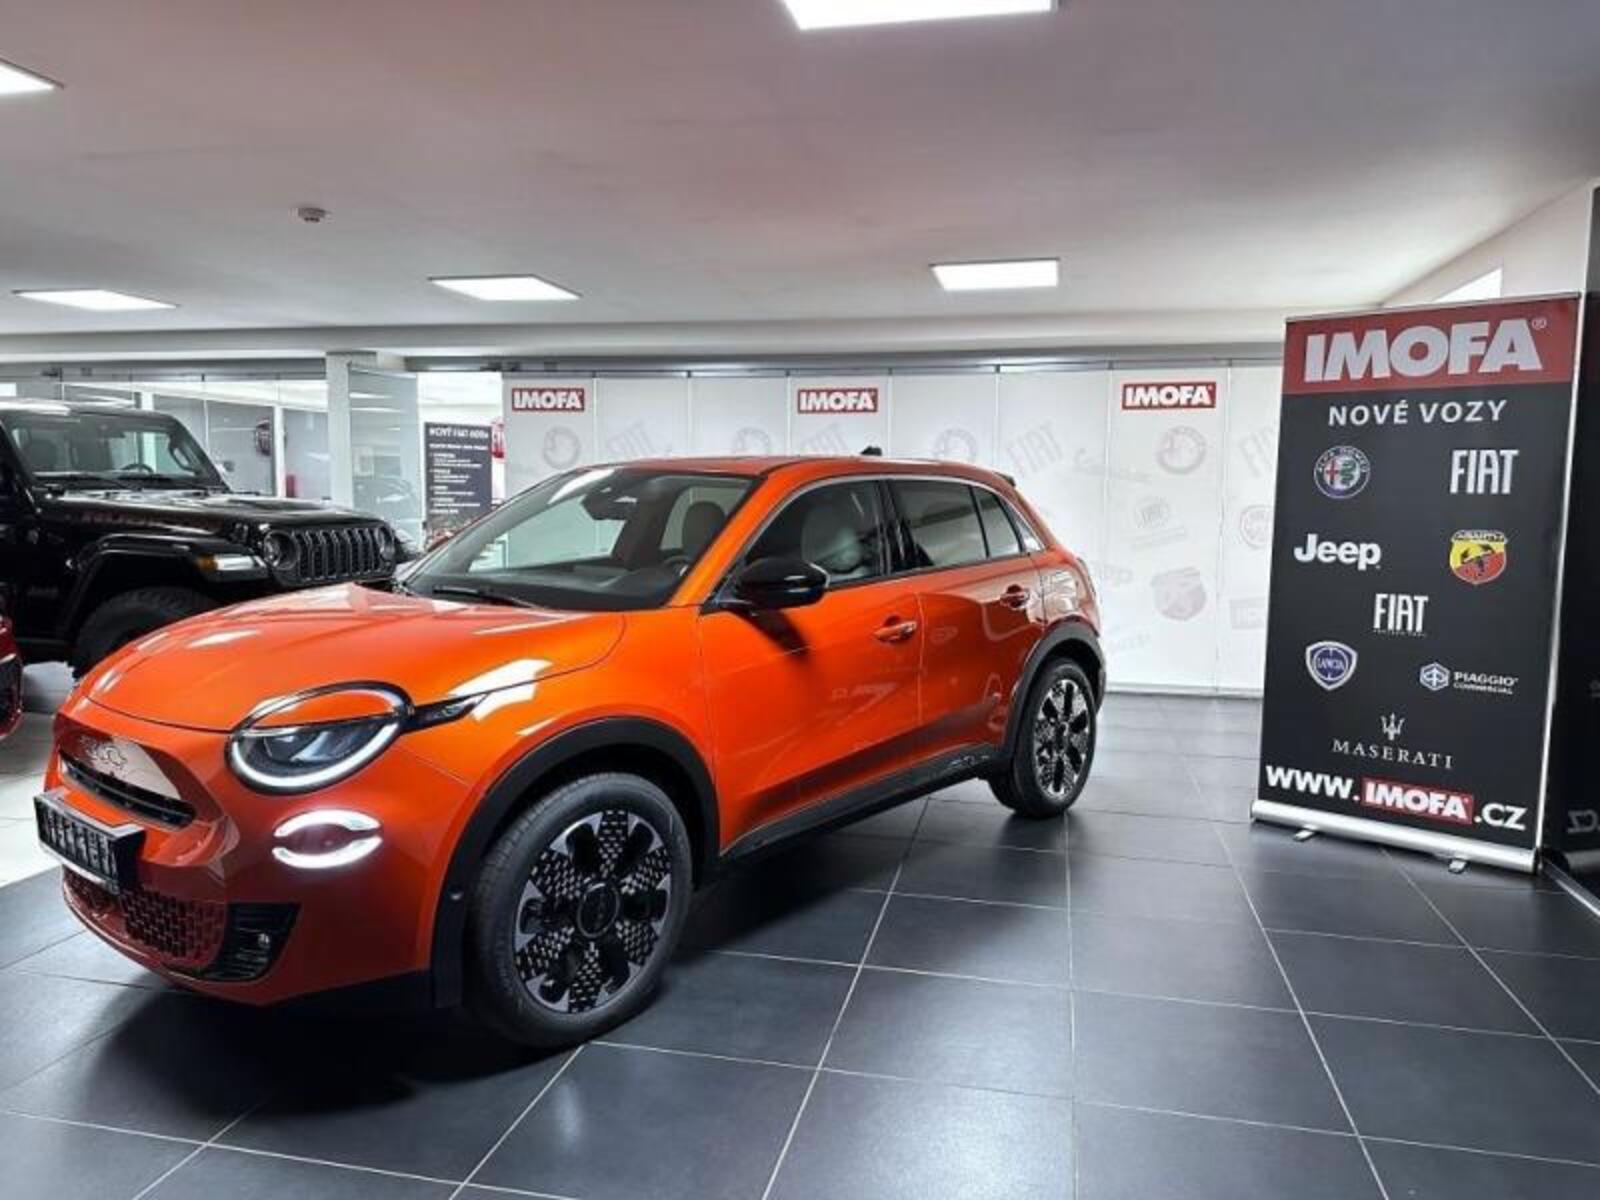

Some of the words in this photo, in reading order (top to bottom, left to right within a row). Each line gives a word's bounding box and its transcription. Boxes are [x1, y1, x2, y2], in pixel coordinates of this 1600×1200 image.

[513, 390, 582, 409] IMOFA
[800, 391, 875, 411] IMOFA
[1125, 385, 1212, 407] IMOFA
[1328, 400, 1409, 426] NOVÉ
[1419, 400, 1507, 423] VOZY
[1450, 450, 1519, 494] FIAT
[1294, 534, 1382, 570] Jeep
[1373, 593, 1429, 632] FIAT
[1454, 671, 1515, 687] PIAGGIO
[1333, 739, 1452, 769] MASERATI
